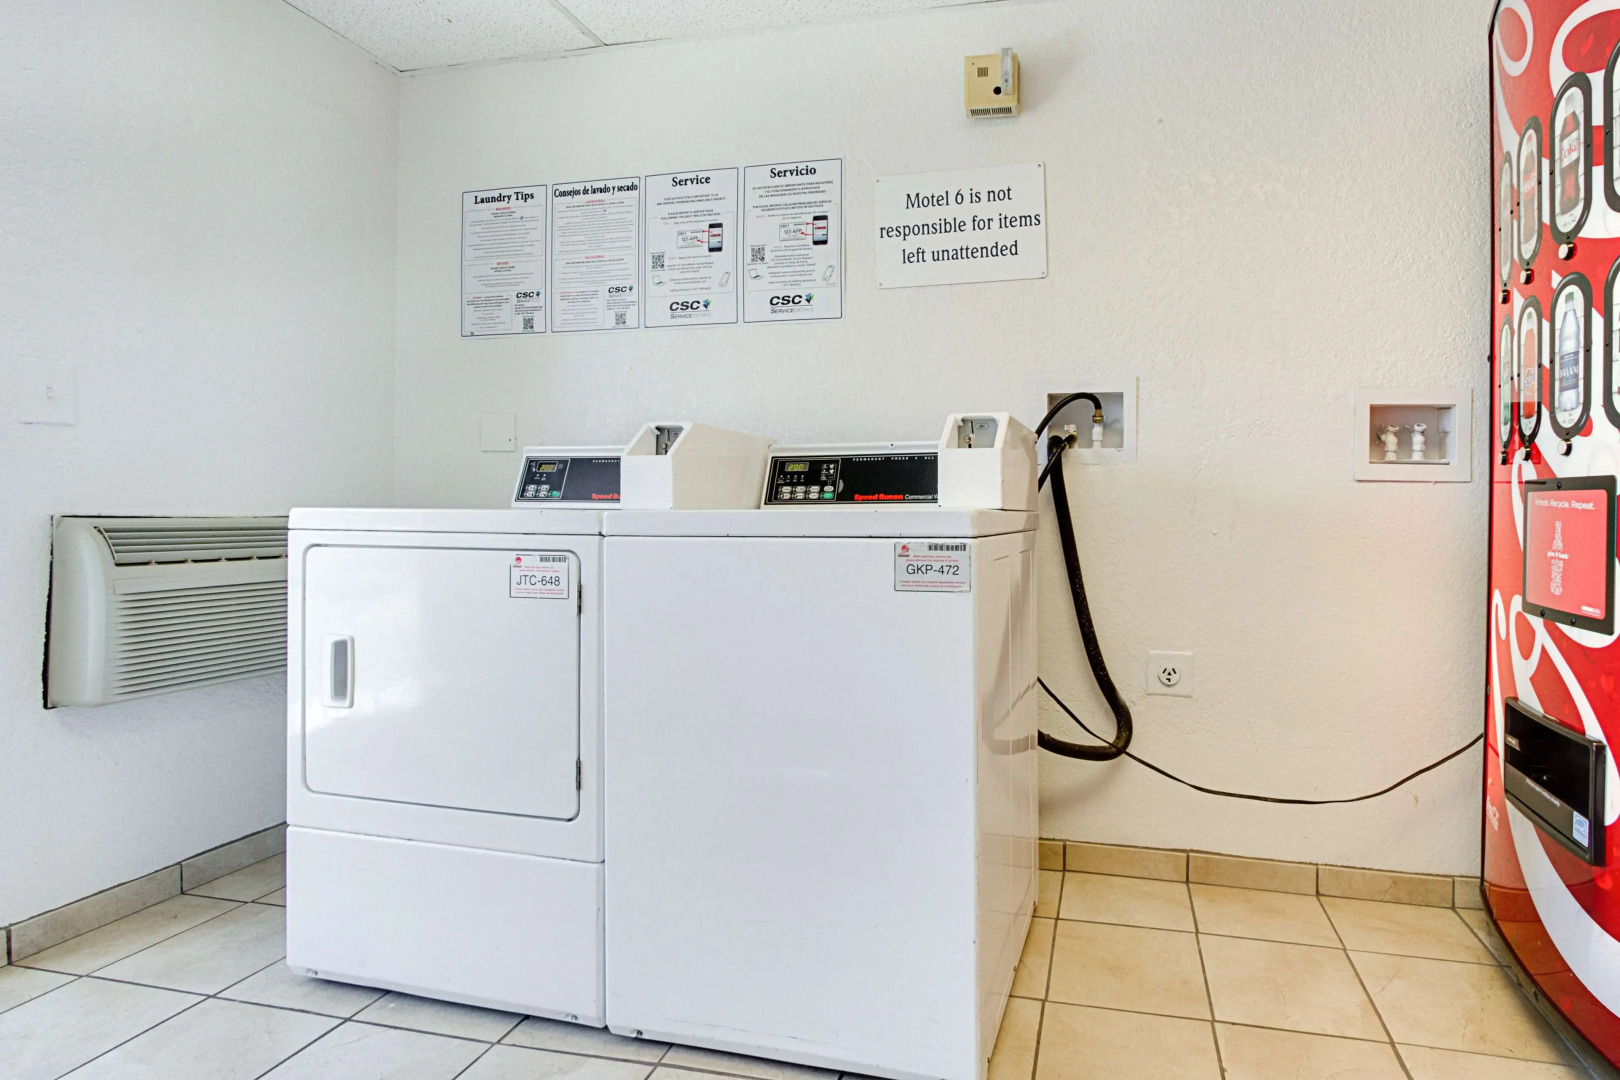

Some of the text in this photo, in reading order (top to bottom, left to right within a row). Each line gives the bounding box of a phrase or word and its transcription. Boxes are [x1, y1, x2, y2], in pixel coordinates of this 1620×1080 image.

[770, 165, 817, 179] Servicio
[671, 174, 711, 187] Service
[554, 182, 638, 199] Consejos de lavado y secado
[474, 191, 534, 205] Laundry Tips
[905, 186, 1012, 210] Motel 6 is not
[880, 213, 1041, 241] responsible for items
[902, 240, 1019, 264] left unattended
[670, 300, 700, 312] CSC
[770, 294, 802, 306] CSC
[854, 494, 878, 502] Speed
[1572, 500, 1596, 510] Repeat.
[906, 564, 960, 576] GKP-472
[516, 574, 560, 586] JTC-648
